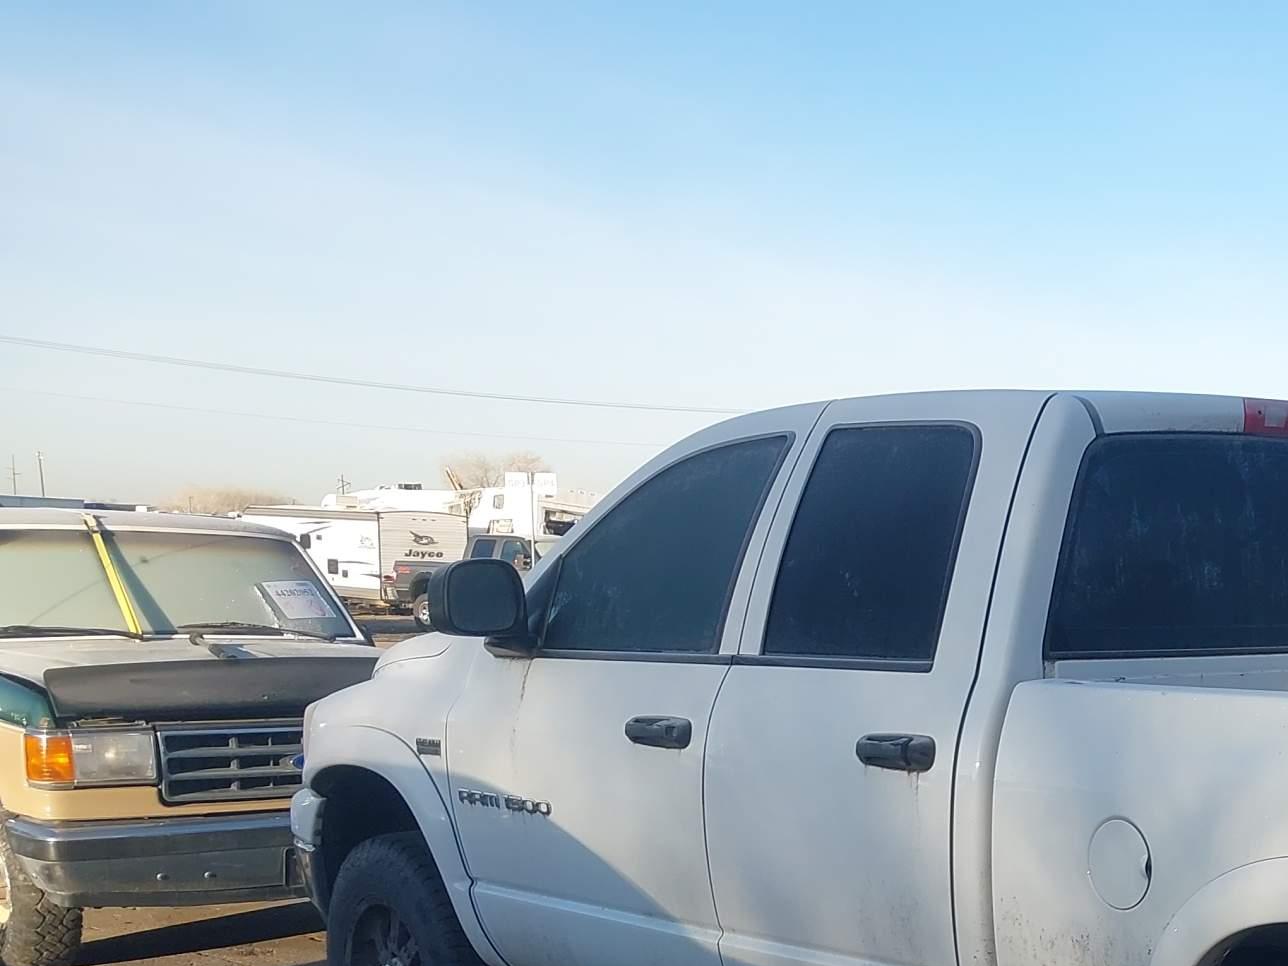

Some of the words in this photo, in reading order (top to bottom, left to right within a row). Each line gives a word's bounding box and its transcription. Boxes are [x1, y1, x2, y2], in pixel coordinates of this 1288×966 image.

[404, 549, 444, 559] Jayco
[458, 788, 500, 809] RAM
[503, 794, 552, 816] 1500
